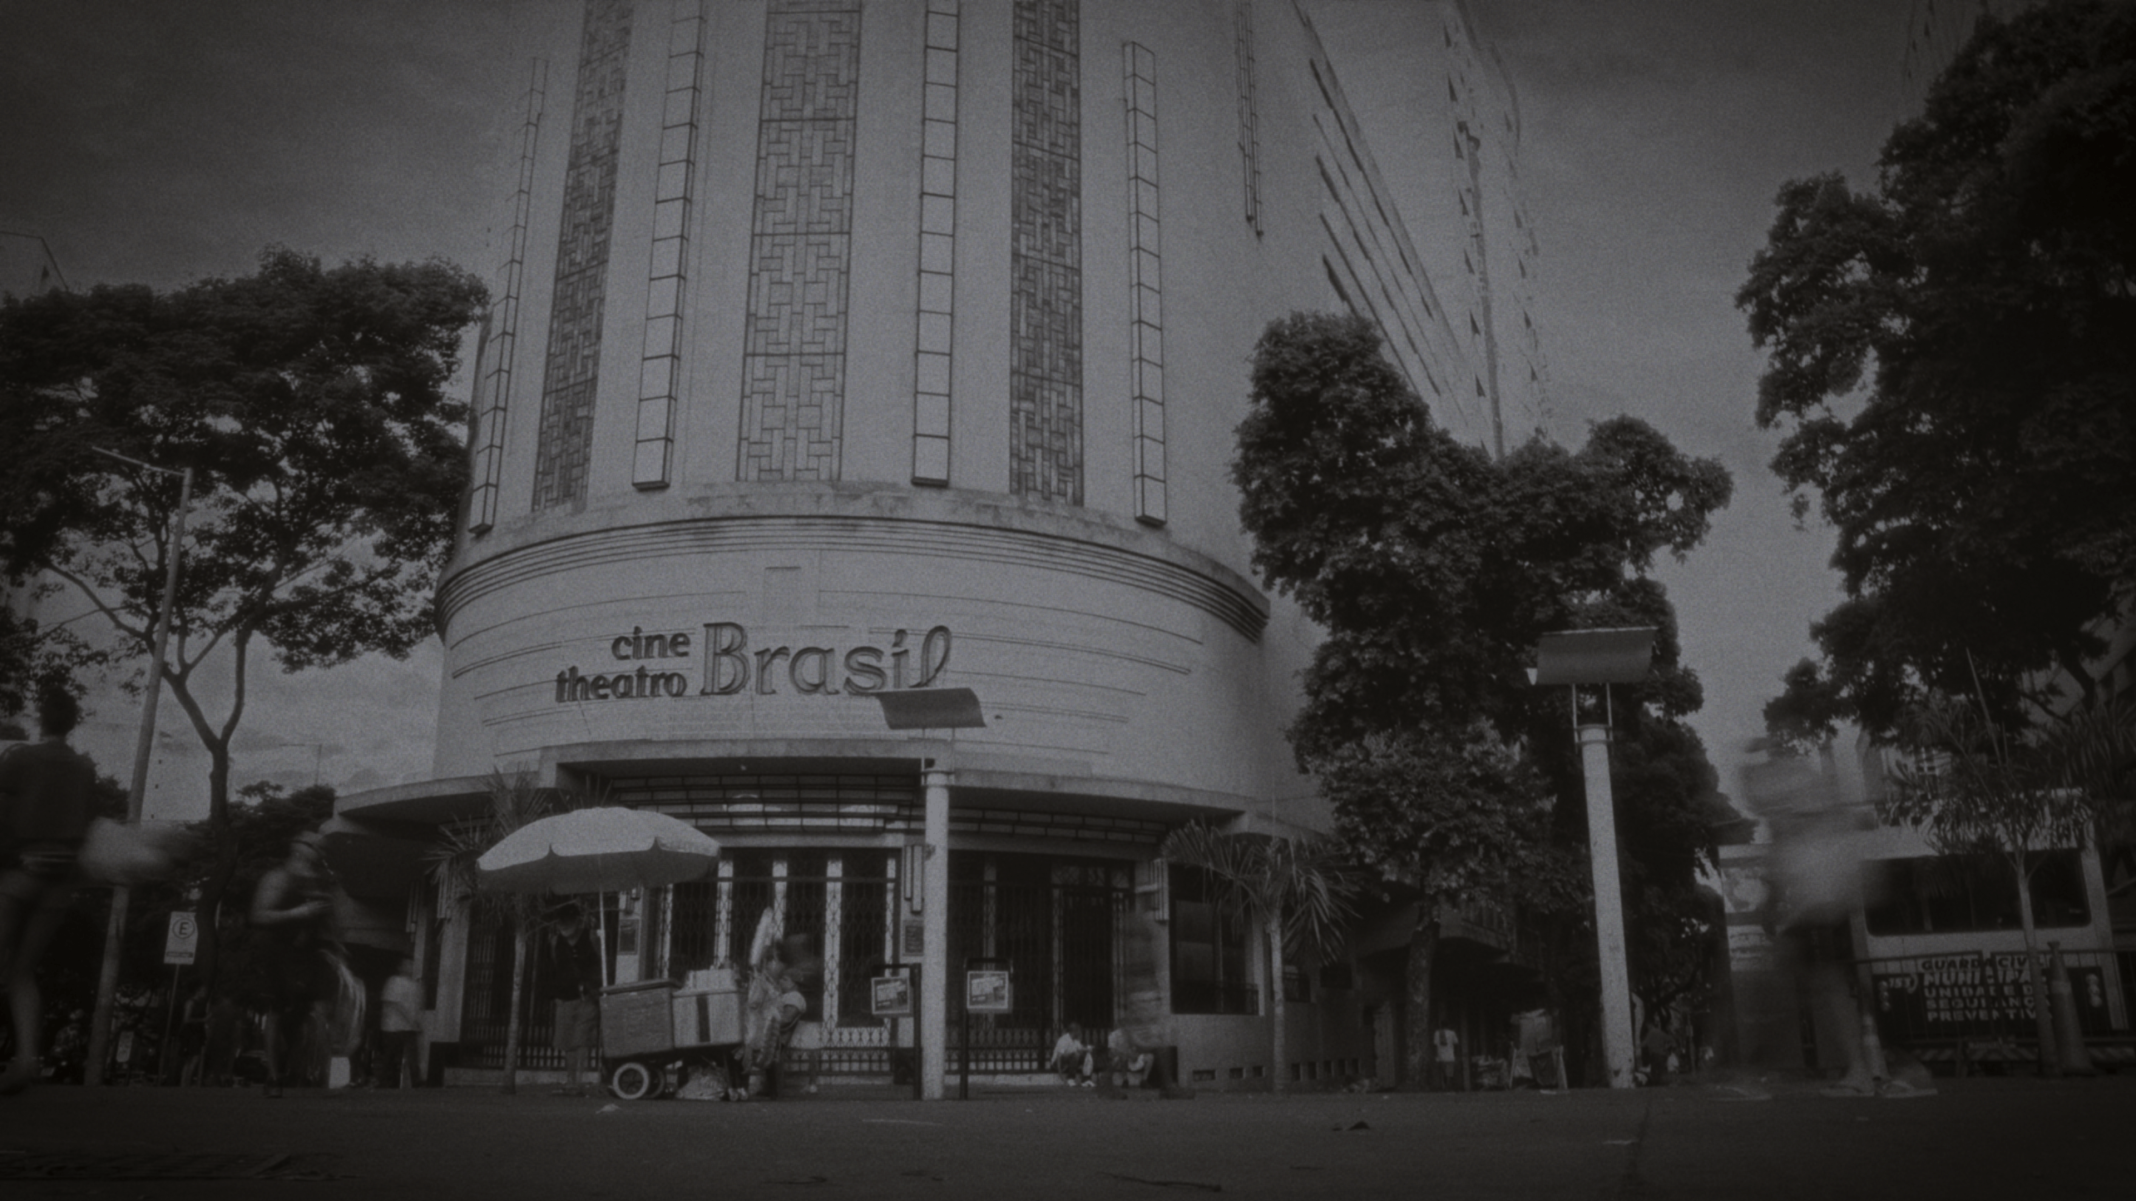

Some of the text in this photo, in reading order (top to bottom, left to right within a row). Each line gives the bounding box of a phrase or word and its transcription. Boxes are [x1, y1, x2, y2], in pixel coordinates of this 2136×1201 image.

[611, 626, 691, 660] cine
[700, 621, 953, 696] Brasil
[555, 665, 688, 702] theatro
[179, 921, 189, 935] E
[1998, 956, 2044, 968] CIVL
[1924, 970, 2046, 986] MUNICIPA
[2022, 984, 2049, 996] D
[1926, 996, 2050, 1010] SEGUANÇ
[1927, 1008, 2052, 1022] PREVENTIV
